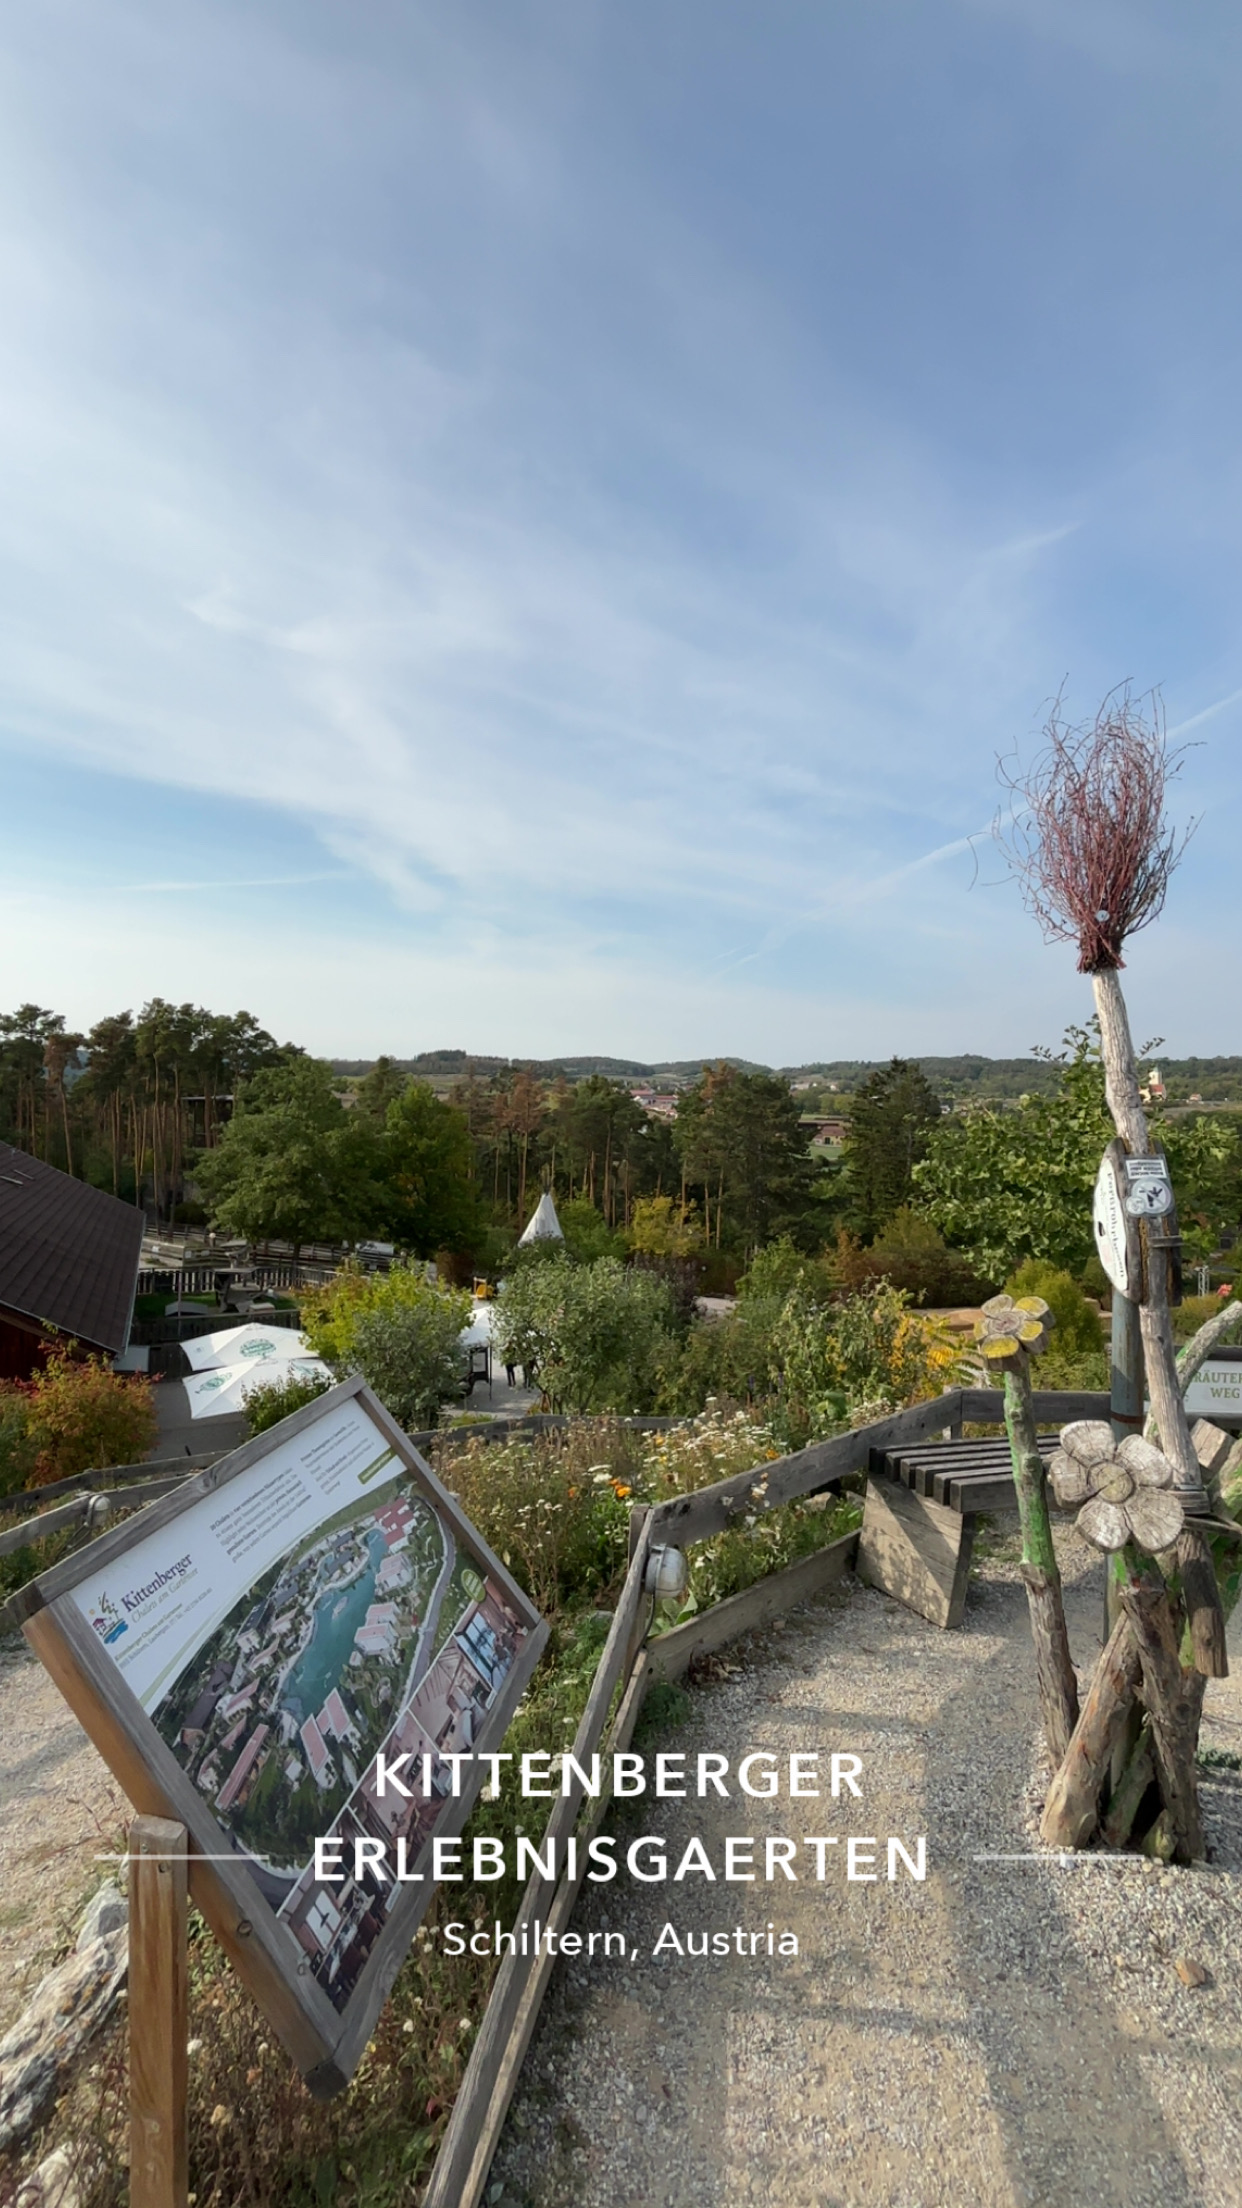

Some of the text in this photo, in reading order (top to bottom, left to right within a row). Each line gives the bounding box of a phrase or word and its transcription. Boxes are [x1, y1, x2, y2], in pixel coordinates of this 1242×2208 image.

[1193, 1369, 1242, 1384] RÄUTE
[1210, 1387, 1240, 1399] WEG
[120, 1553, 193, 1613] Kittenberger
